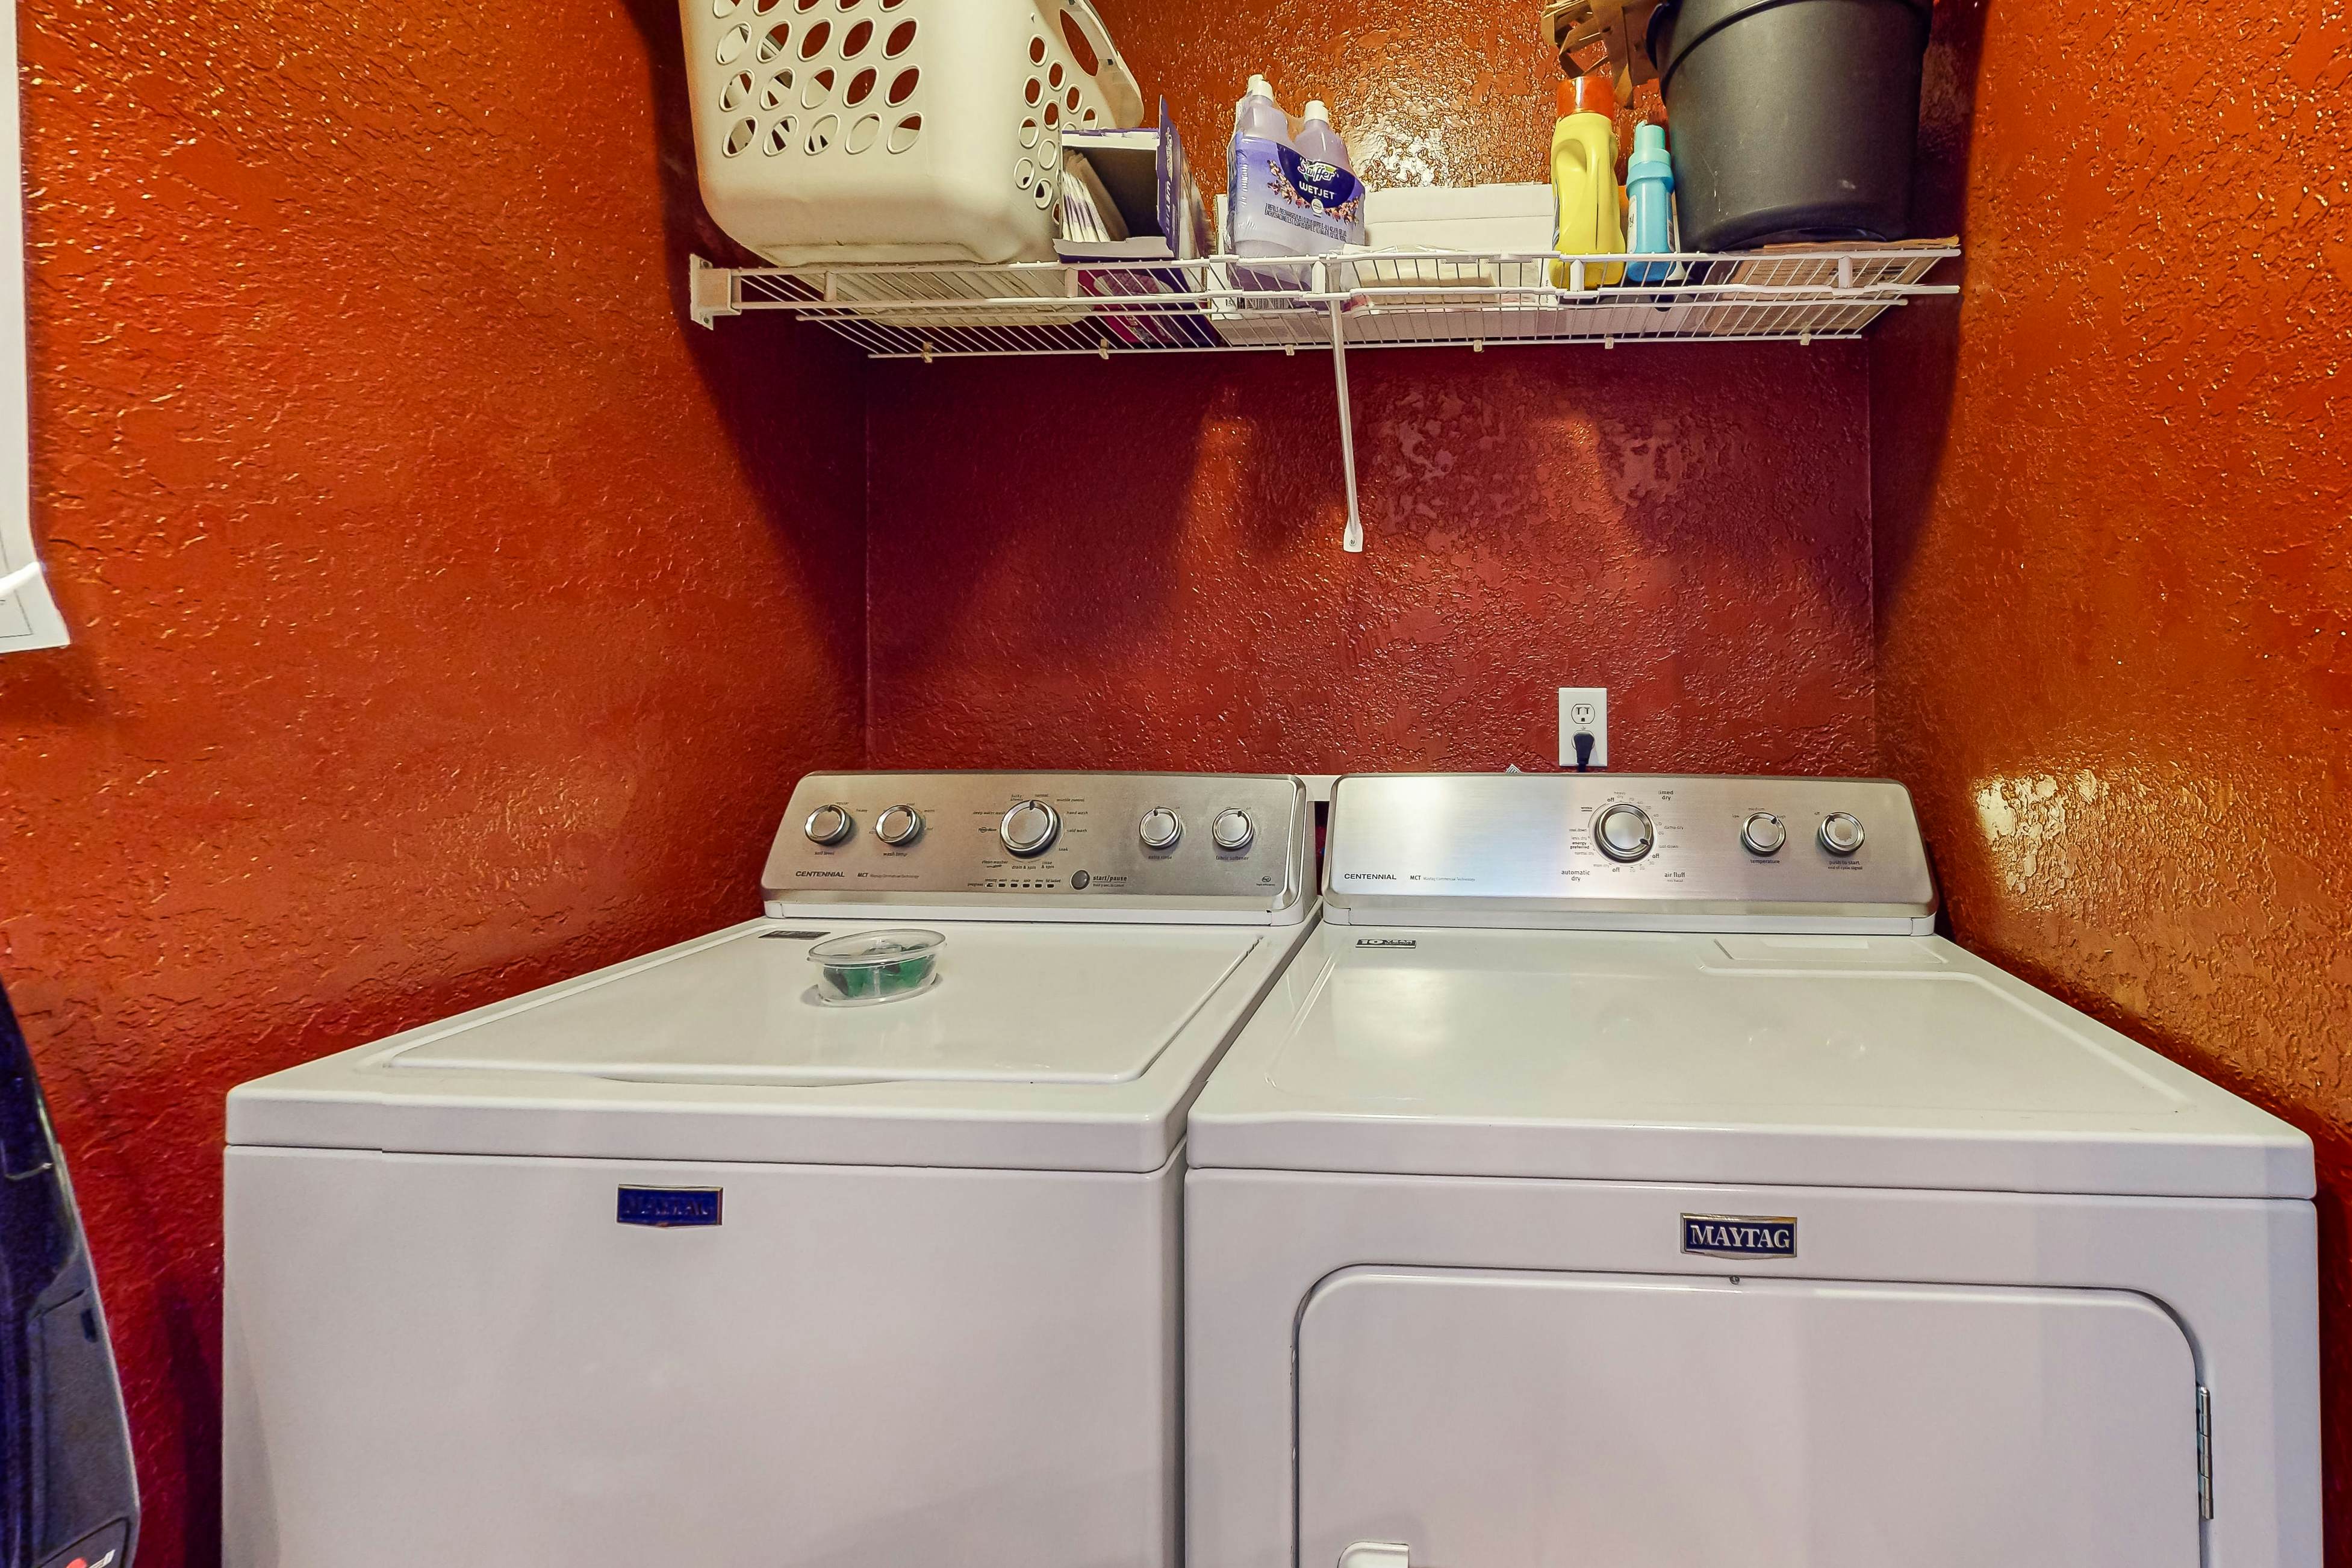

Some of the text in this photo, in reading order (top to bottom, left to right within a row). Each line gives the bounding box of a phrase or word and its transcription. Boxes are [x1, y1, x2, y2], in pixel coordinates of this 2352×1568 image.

[1298, 158, 1336, 182] Swiffer
[1299, 181, 1335, 200] WETJET
[1690, 1224, 1790, 1249] MAYTAG
